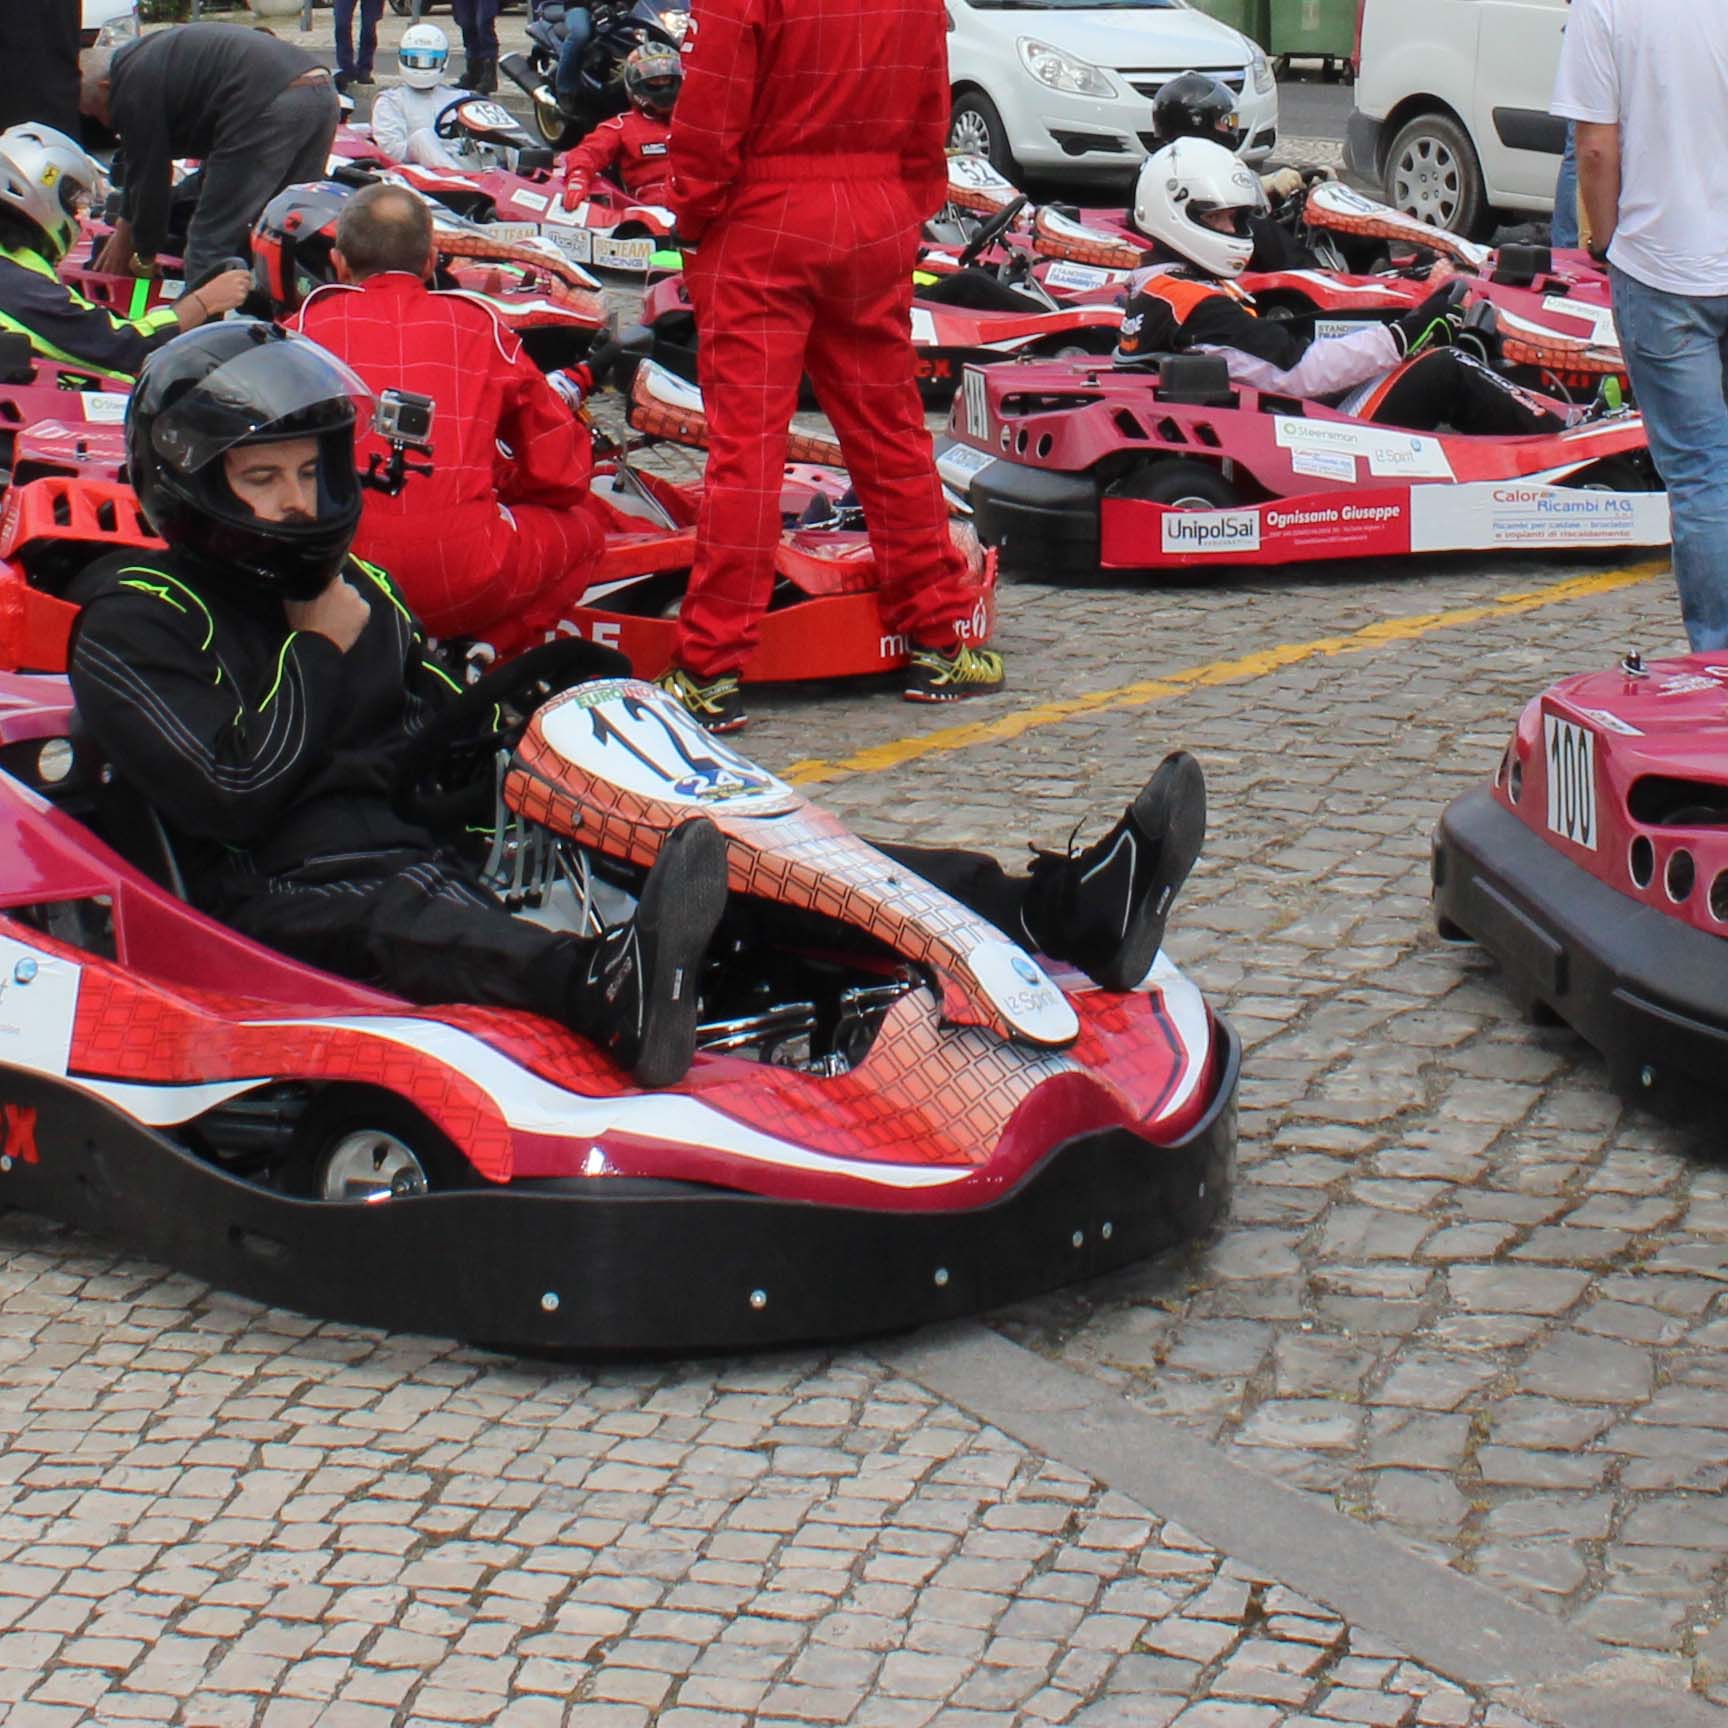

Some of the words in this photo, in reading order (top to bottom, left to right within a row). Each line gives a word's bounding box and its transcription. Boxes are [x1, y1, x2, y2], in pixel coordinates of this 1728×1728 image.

[1298, 426, 1358, 444] Steersman
[1492, 489, 1538, 503] Calor
[1536, 500, 1599, 513] Ricambi
[1266, 509, 1339, 529] Ognissanto
[1342, 505, 1401, 521] Giuseppe
[1167, 518, 1254, 545] UnipolSai
[576, 683, 662, 711] EUROINDY
[1551, 719, 1590, 845] 100
